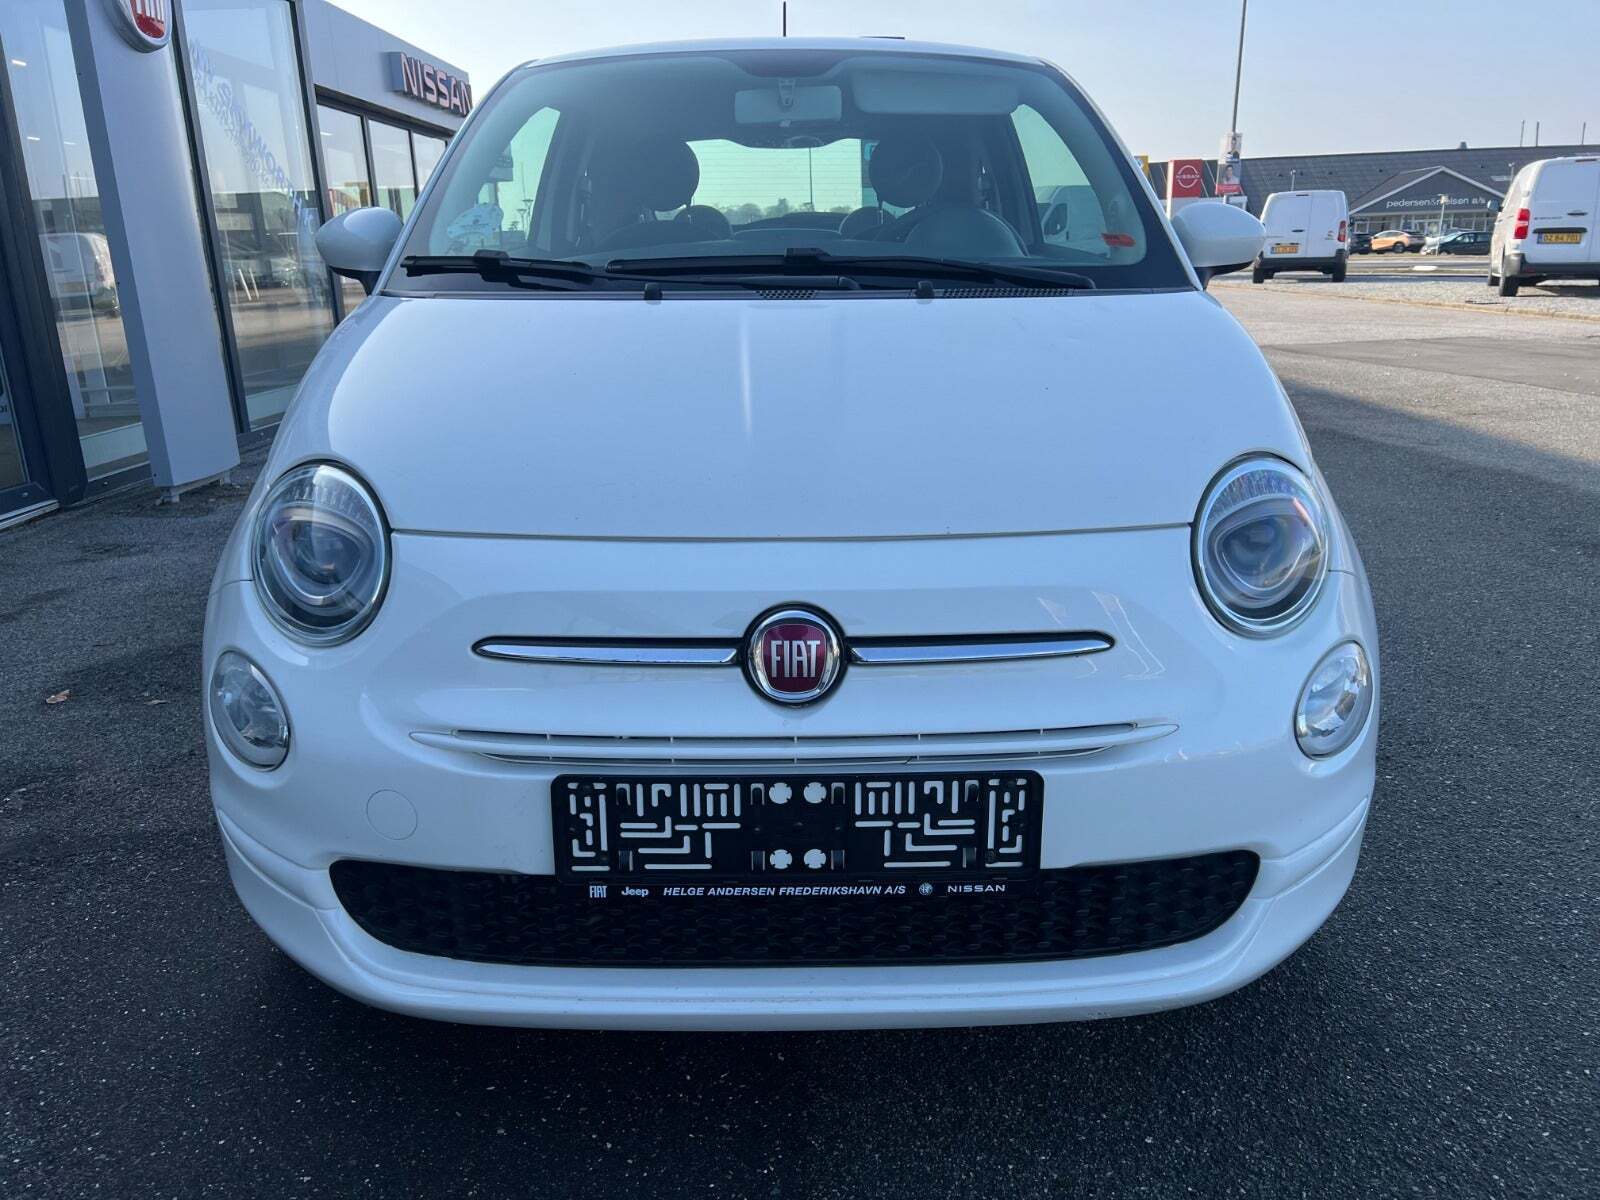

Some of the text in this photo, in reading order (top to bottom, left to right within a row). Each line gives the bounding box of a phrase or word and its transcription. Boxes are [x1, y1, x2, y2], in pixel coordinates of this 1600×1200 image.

[401, 52, 472, 116] NISSAN
[771, 640, 820, 678] FIAT
[589, 884, 1006, 898] FIAT Jeep HELGE ANDERSEN FREDERIKSHAVN A/S NISSAN
